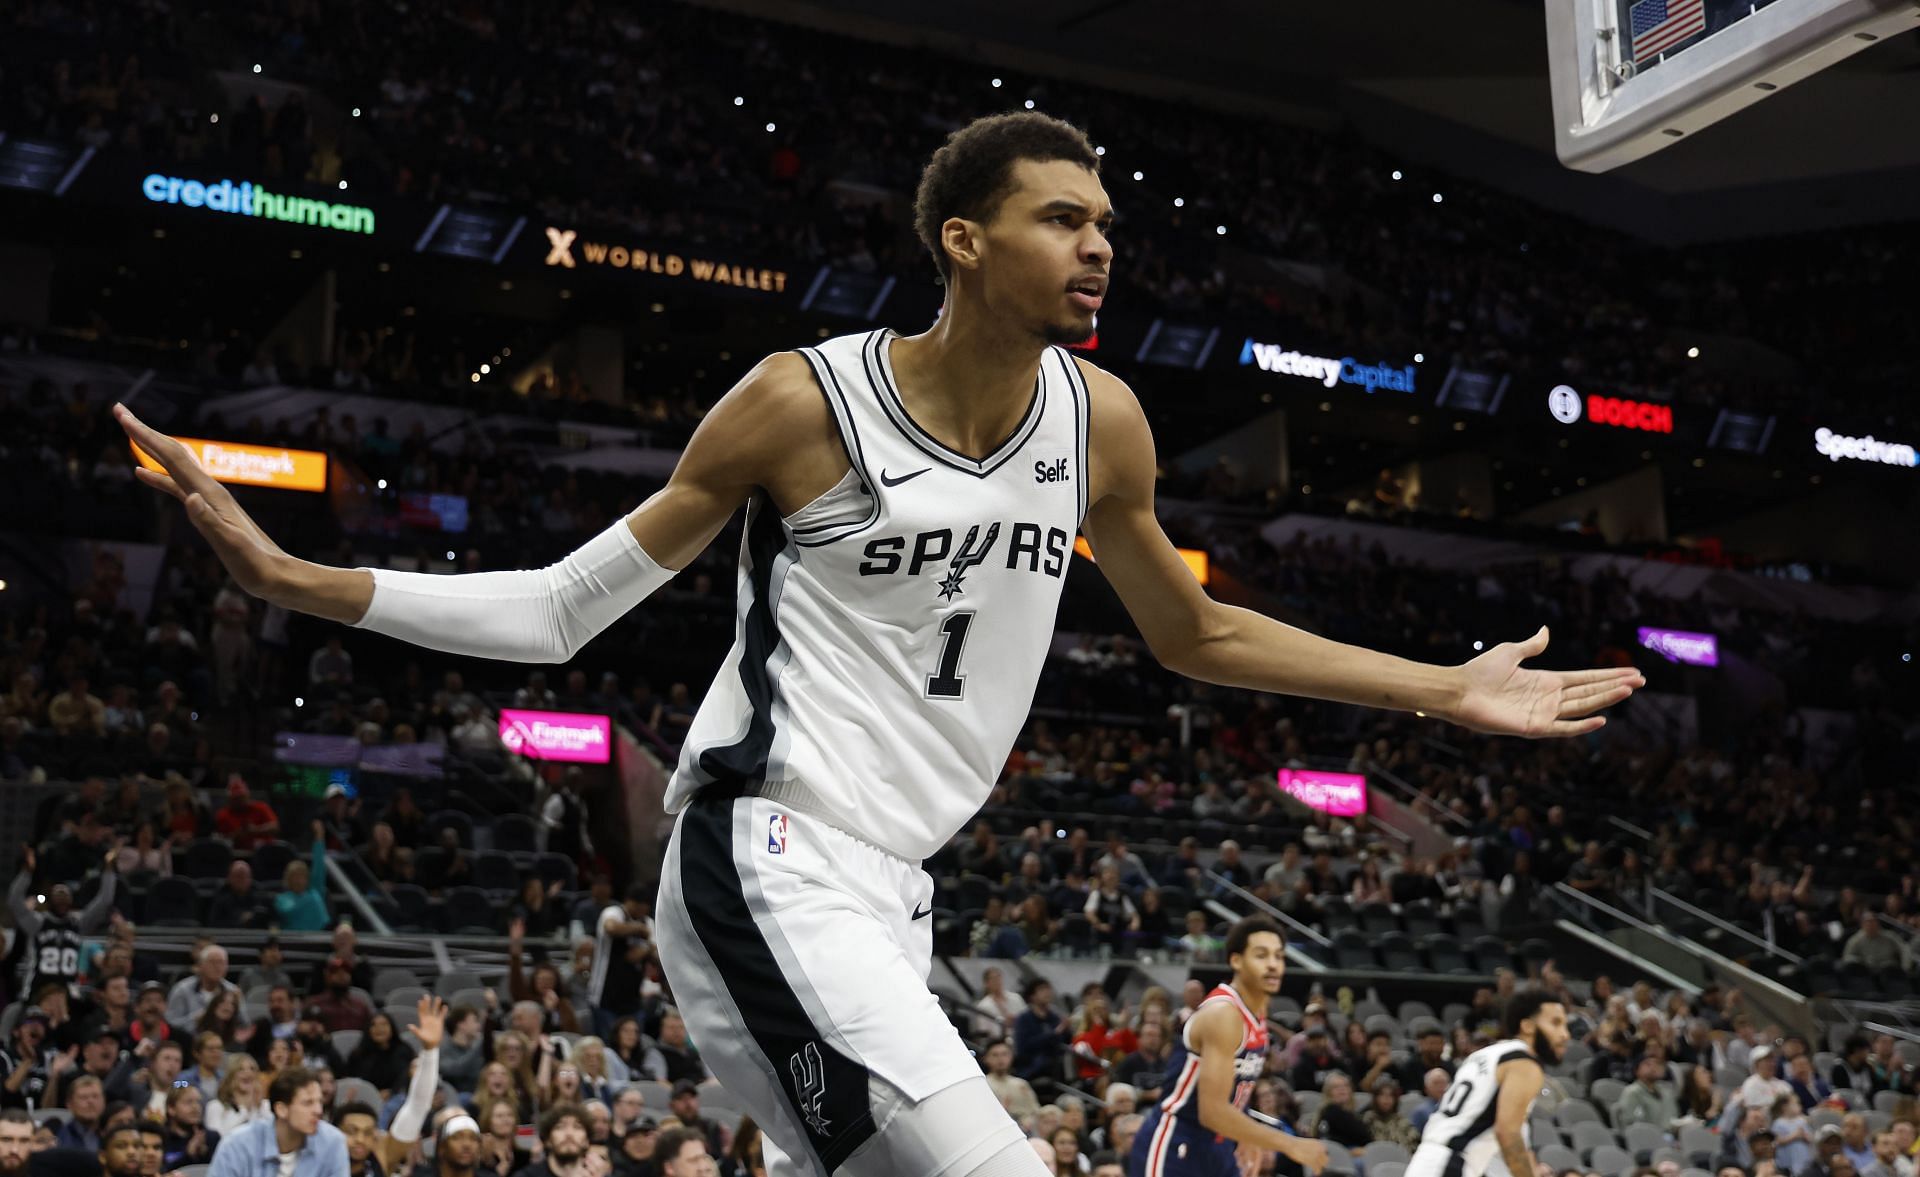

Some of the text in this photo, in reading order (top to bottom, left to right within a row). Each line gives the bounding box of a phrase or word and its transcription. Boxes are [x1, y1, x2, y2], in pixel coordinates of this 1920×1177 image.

[143, 174, 374, 234] credithuman
[583, 242, 684, 276] WORLD
[690, 259, 787, 292] WALLET
[1588, 395, 1673, 433] BOSCH
[1815, 427, 1915, 467] Spectrum
[1034, 458, 1070, 483] Self.
[859, 522, 1067, 602] SPURS
[924, 609, 977, 701] 1
[40, 946, 78, 975] 20
